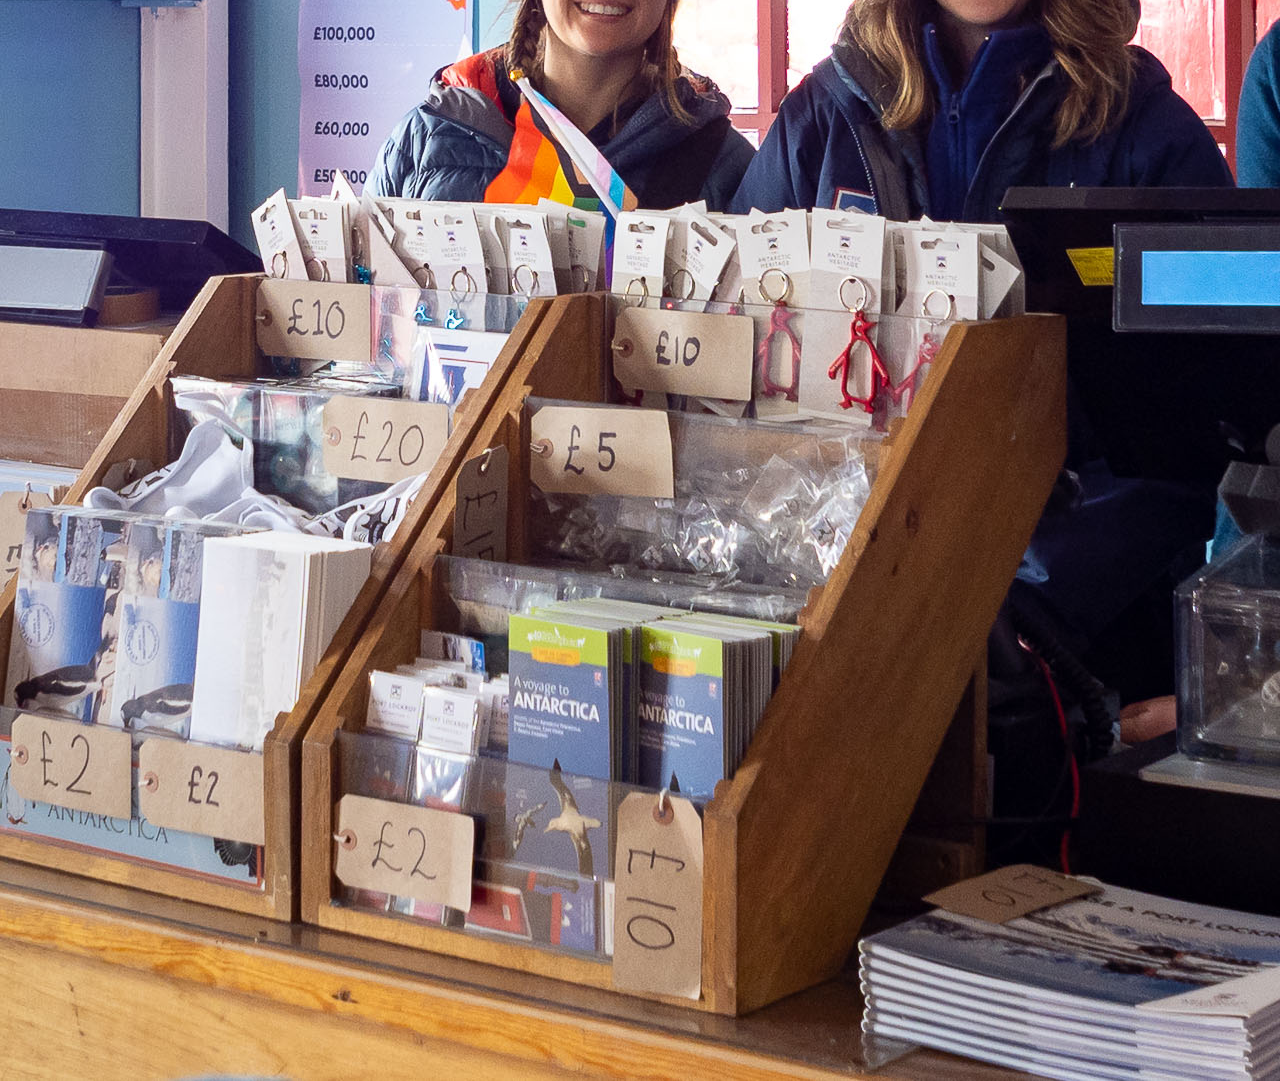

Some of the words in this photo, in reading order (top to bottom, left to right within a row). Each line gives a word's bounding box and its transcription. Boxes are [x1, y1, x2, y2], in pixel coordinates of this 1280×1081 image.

[313, 26, 375, 43] £100,000
[314, 74, 369, 91] £80,000
[314, 121, 369, 137] £60,000
[287, 298, 345, 339] £10
[655, 330, 701, 367] £10
[350, 411, 425, 466] £20
[514, 676, 521, 687] A
[523, 680, 556, 696] voyage
[559, 684, 570, 696] to
[675, 696, 685, 708] to
[514, 691, 600, 722] ANTARCTICA
[40, 730, 92, 795] £2
[188, 765, 219, 807] £2
[371, 821, 437, 880] £2
[626, 848, 685, 950] £10
